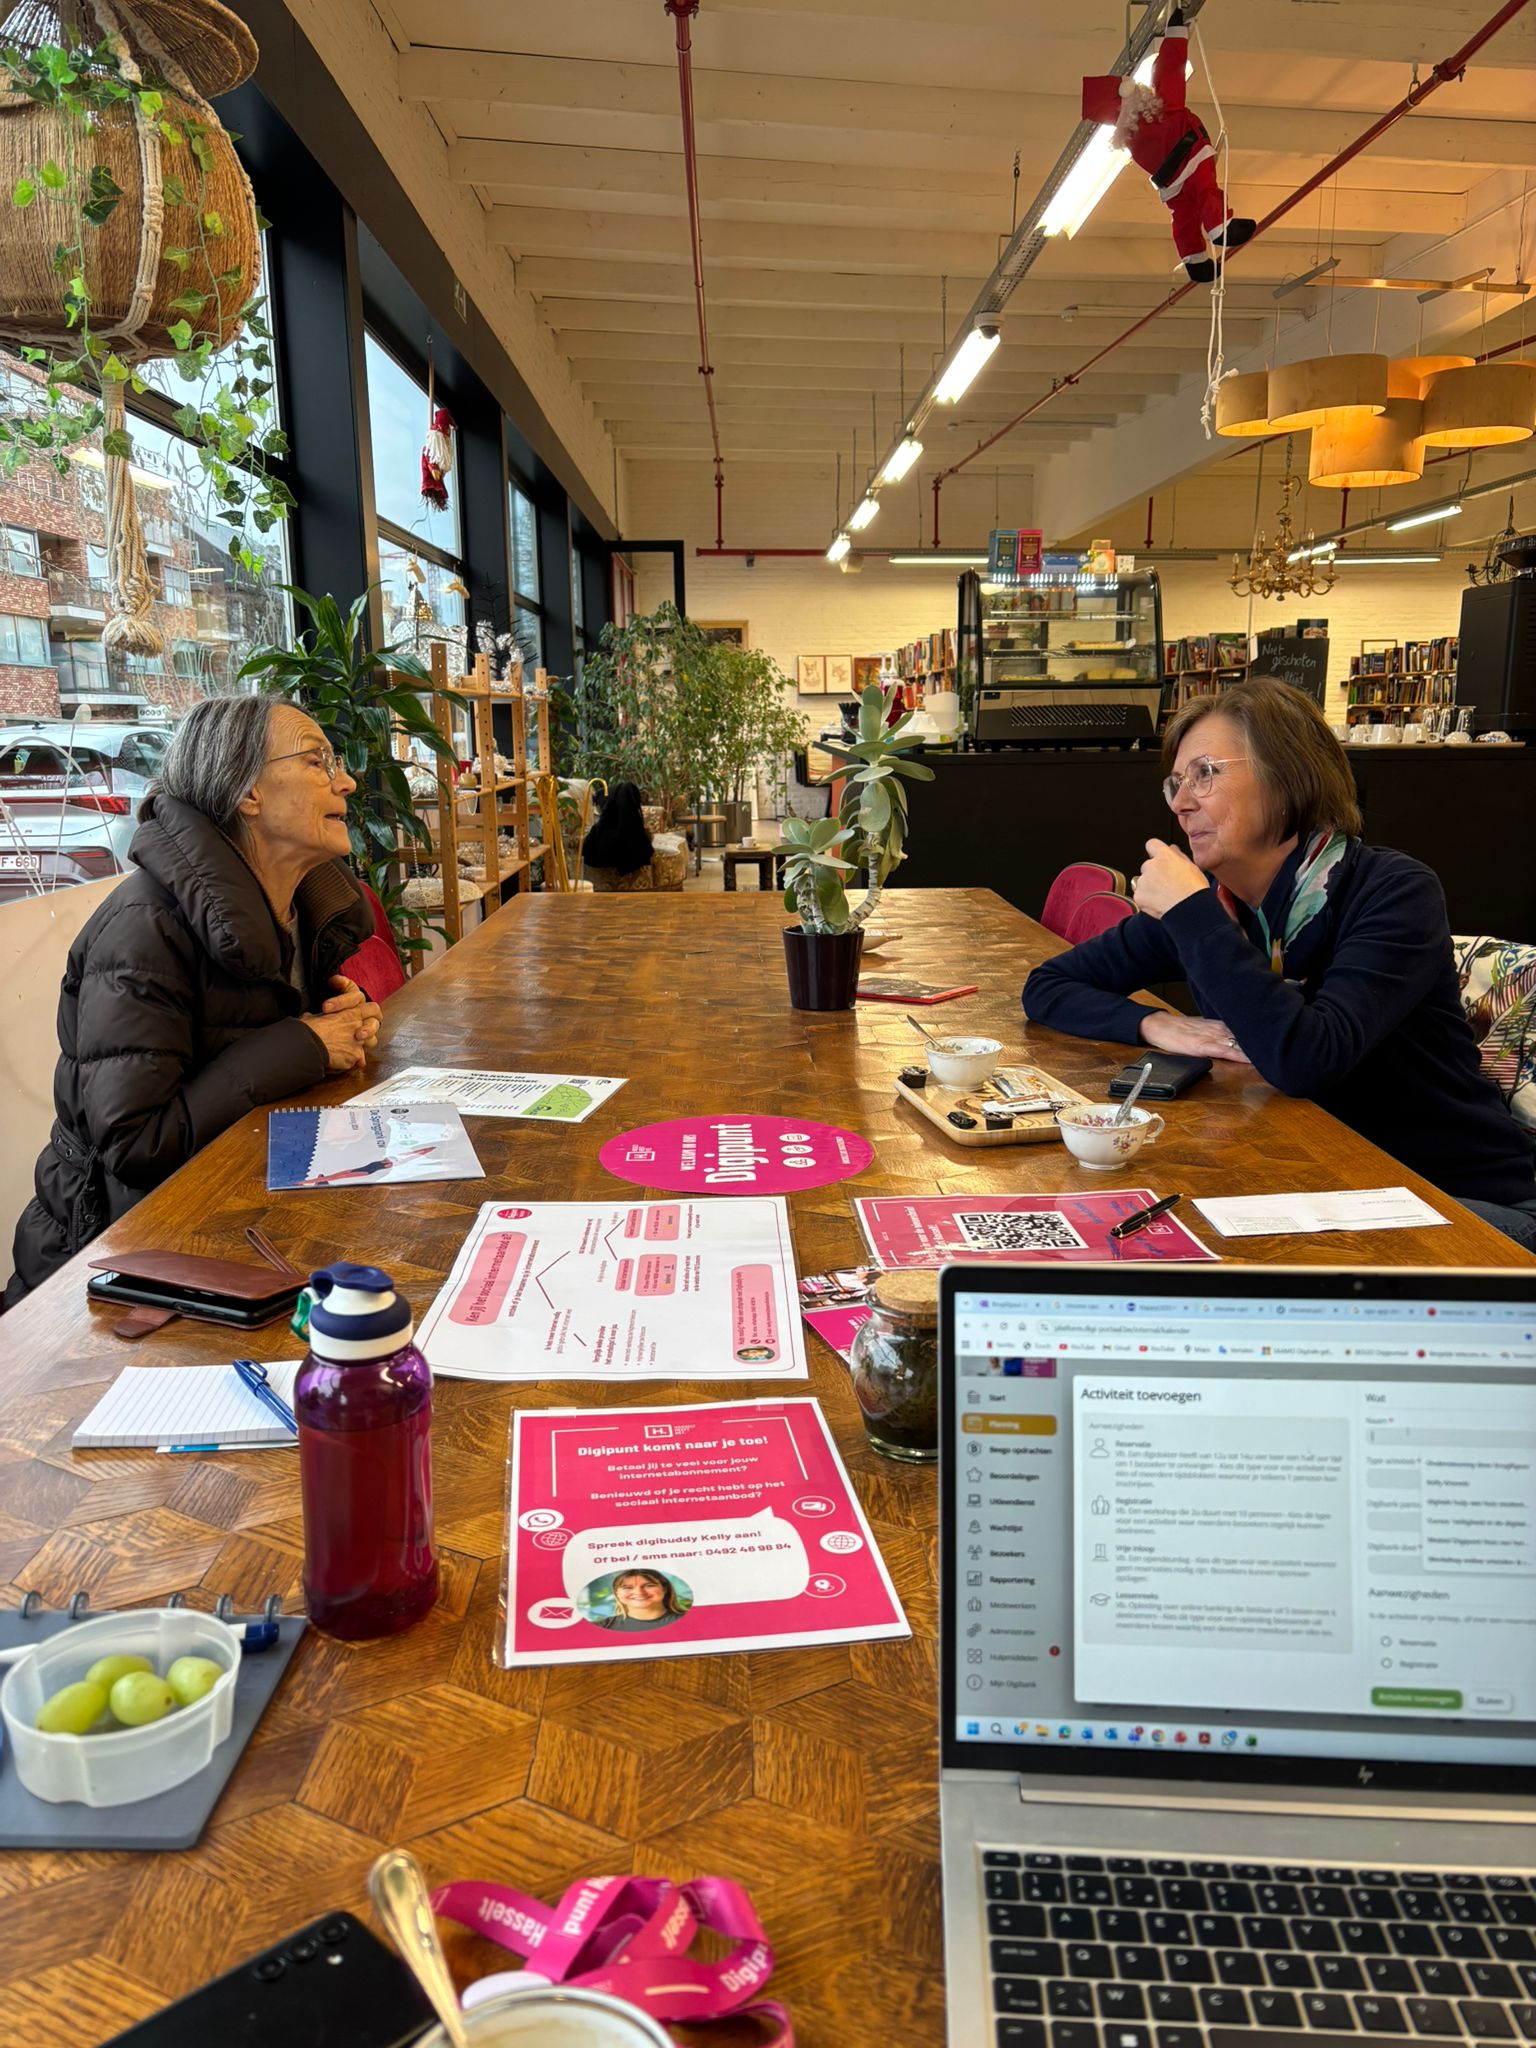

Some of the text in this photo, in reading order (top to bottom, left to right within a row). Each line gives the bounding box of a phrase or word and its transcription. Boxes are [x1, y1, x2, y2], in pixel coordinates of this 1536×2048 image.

[1262, 643, 1285, 655] Niet
[1270, 653, 1317, 671] geschoten
[704, 1123, 770, 1183] Digipunt
[479, 1281, 495, 1296] sociaal
[473, 1297, 487, 1305] het
[466, 1312, 480, 1322] Ken
[989, 1394, 1005, 1402] Start
[1082, 1389, 1200, 1402] Activiteit toevoegen
[1365, 1393, 1386, 1403] Wat
[578, 1436, 767, 1457] Digipunt komt naar je toe!
[1012, 1447, 1051, 1455] opdrachten
[607, 1463, 645, 1472] Betaal
[647, 1462, 658, 1470] jij
[730, 1456, 758, 1464] jouw
[619, 1465, 746, 1480] internetabonnement?
[990, 1473, 1039, 1481] Beoordelingen
[590, 1490, 651, 1500] Benieuwd
[654, 1488, 666, 1496] of
[682, 1486, 714, 1494] recht
[717, 1483, 744, 1492] hebt
[615, 1492, 761, 1507] sociaal internetaanbod?
[1115, 1498, 1152, 1506] Registratie
[588, 1531, 760, 1550] Spreek digibuddy Kelly aan!
[594, 1556, 608, 1564] Of
[610, 1555, 630, 1563] bel
[633, 1554, 638, 1562] /
[642, 1553, 667, 1561] sms
[670, 1550, 702, 1558] naar:
[705, 1547, 736, 1556] 0492
[775, 1542, 790, 1550] 84
[990, 1577, 1035, 1585] Rapportering
[1368, 1588, 1449, 1601] Aanwezigheden
[990, 1602, 1036, 1610] Medewerkers
[563, 1889, 599, 1935] punt
[1060, 1913, 1072, 1922] A
[478, 1896, 548, 1948] Hasselt
[1155, 1917, 1166, 1928] E
[1126, 1952, 1137, 1963] S
[1175, 1954, 1188, 1966] D
[1107, 1990, 1125, 2000] W
[1209, 1995, 1223, 2006] C
